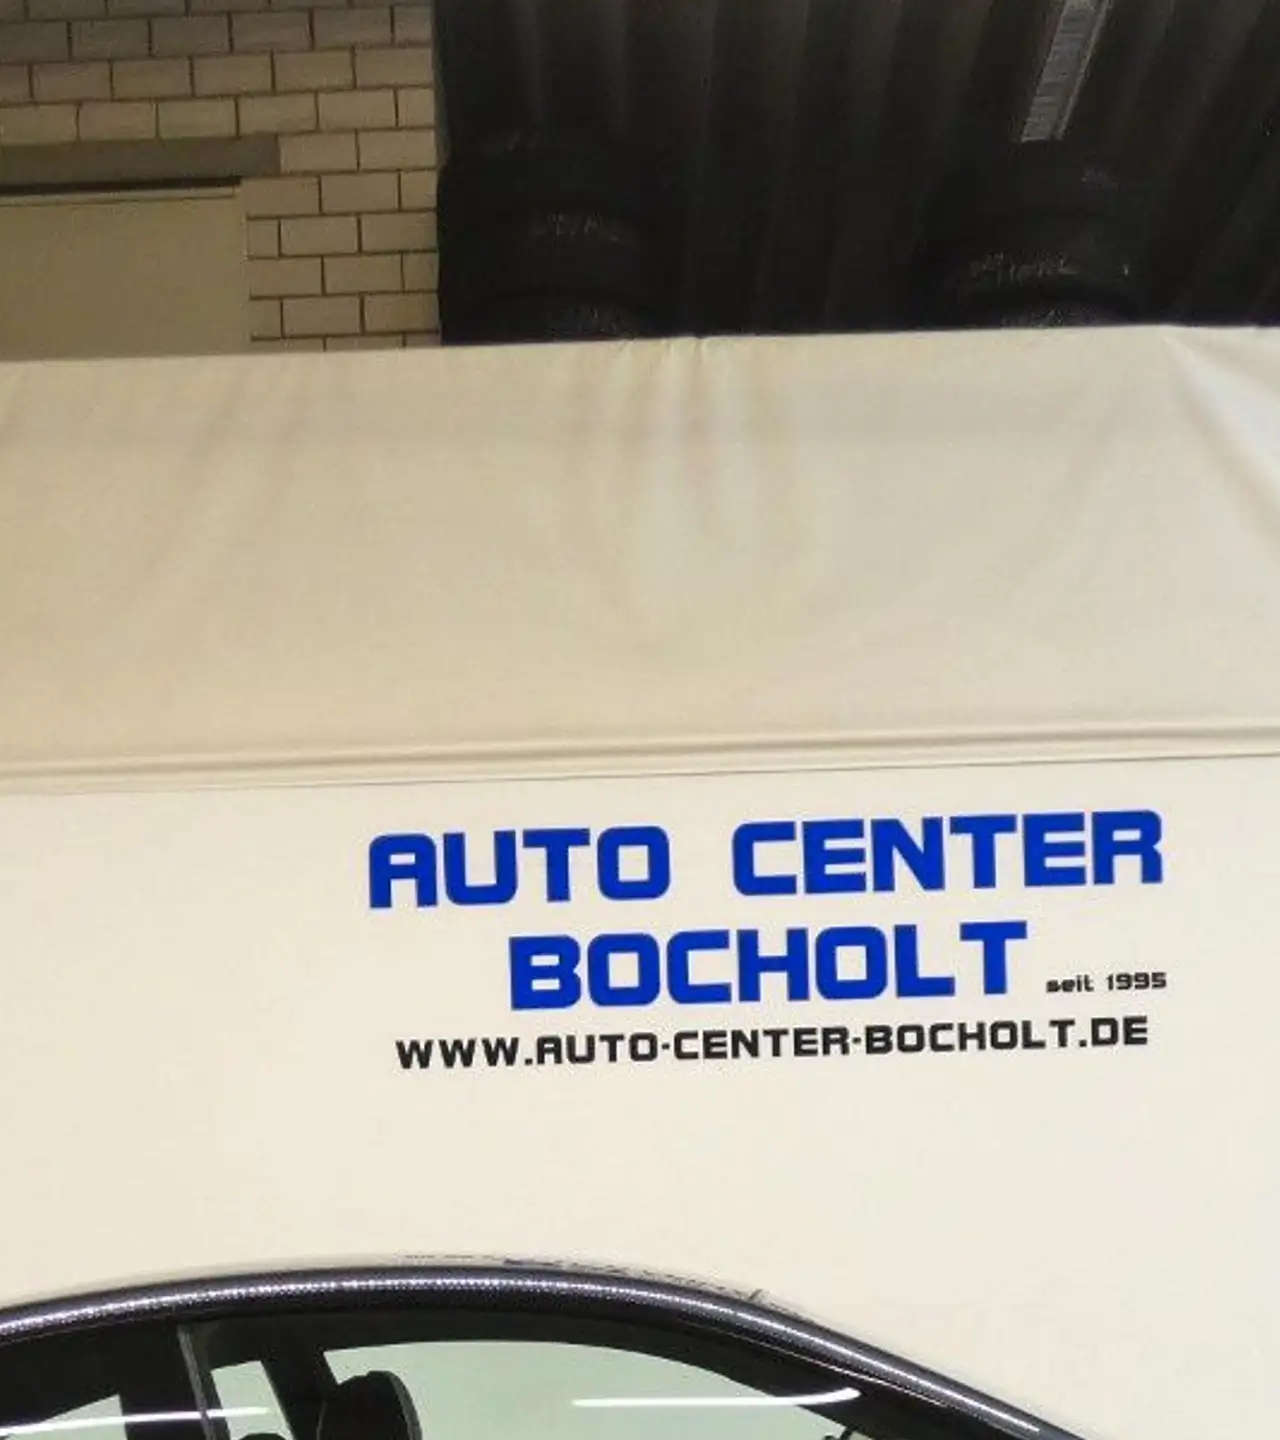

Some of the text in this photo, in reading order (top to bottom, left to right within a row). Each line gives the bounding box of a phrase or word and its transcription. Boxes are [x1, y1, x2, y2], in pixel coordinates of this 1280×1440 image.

[369, 809, 1164, 909] AUTO CENTER
[509, 919, 1167, 1012] BOCHOLT seit 1995
[394, 1014, 1149, 1070] WWW.AUTO-CENTER-BOCHOLT.DE
